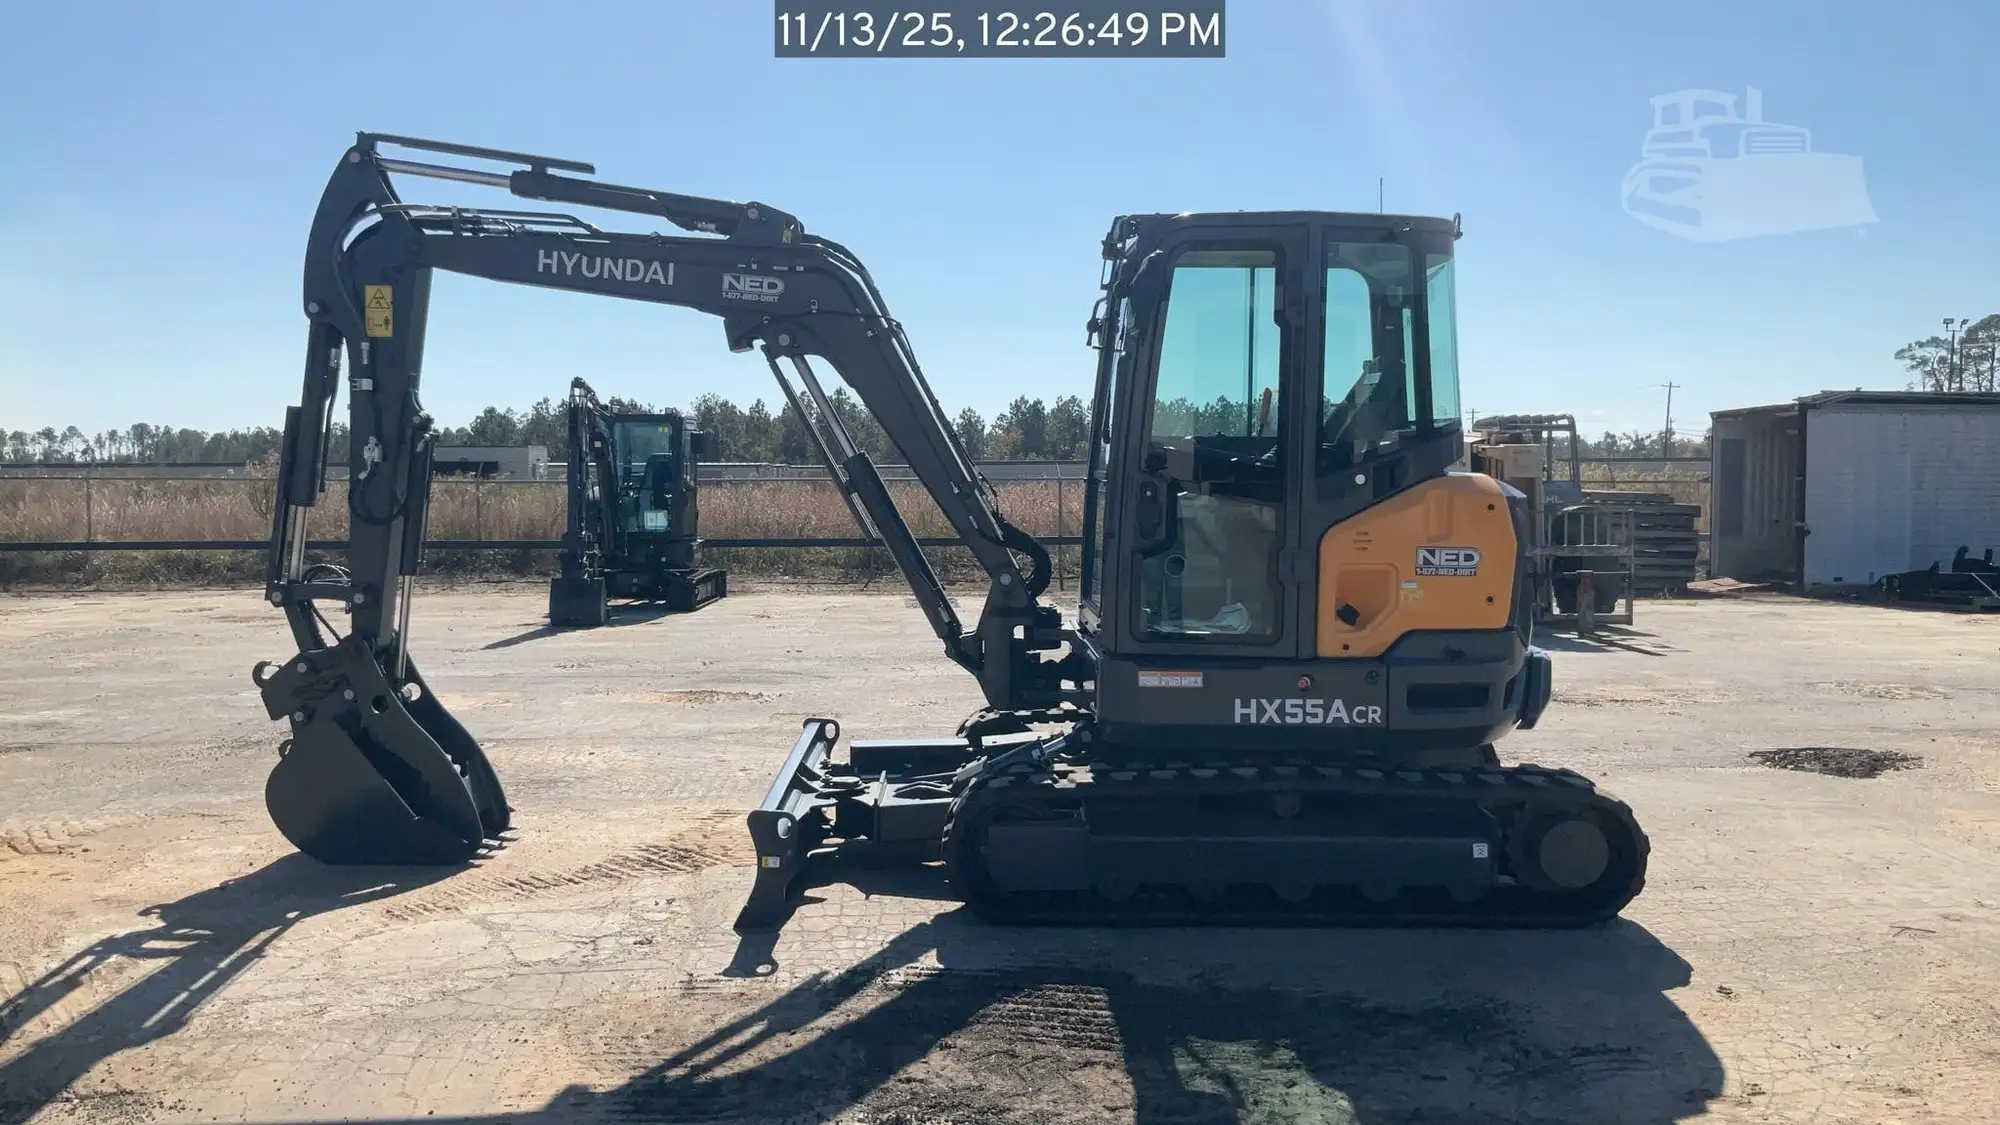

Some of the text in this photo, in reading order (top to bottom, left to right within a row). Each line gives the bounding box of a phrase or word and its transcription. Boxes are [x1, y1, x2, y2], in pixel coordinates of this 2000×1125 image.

[537, 249, 674, 286] HYUNDAI
[723, 275, 784, 295] NED
[1417, 548, 1480, 567] NED
